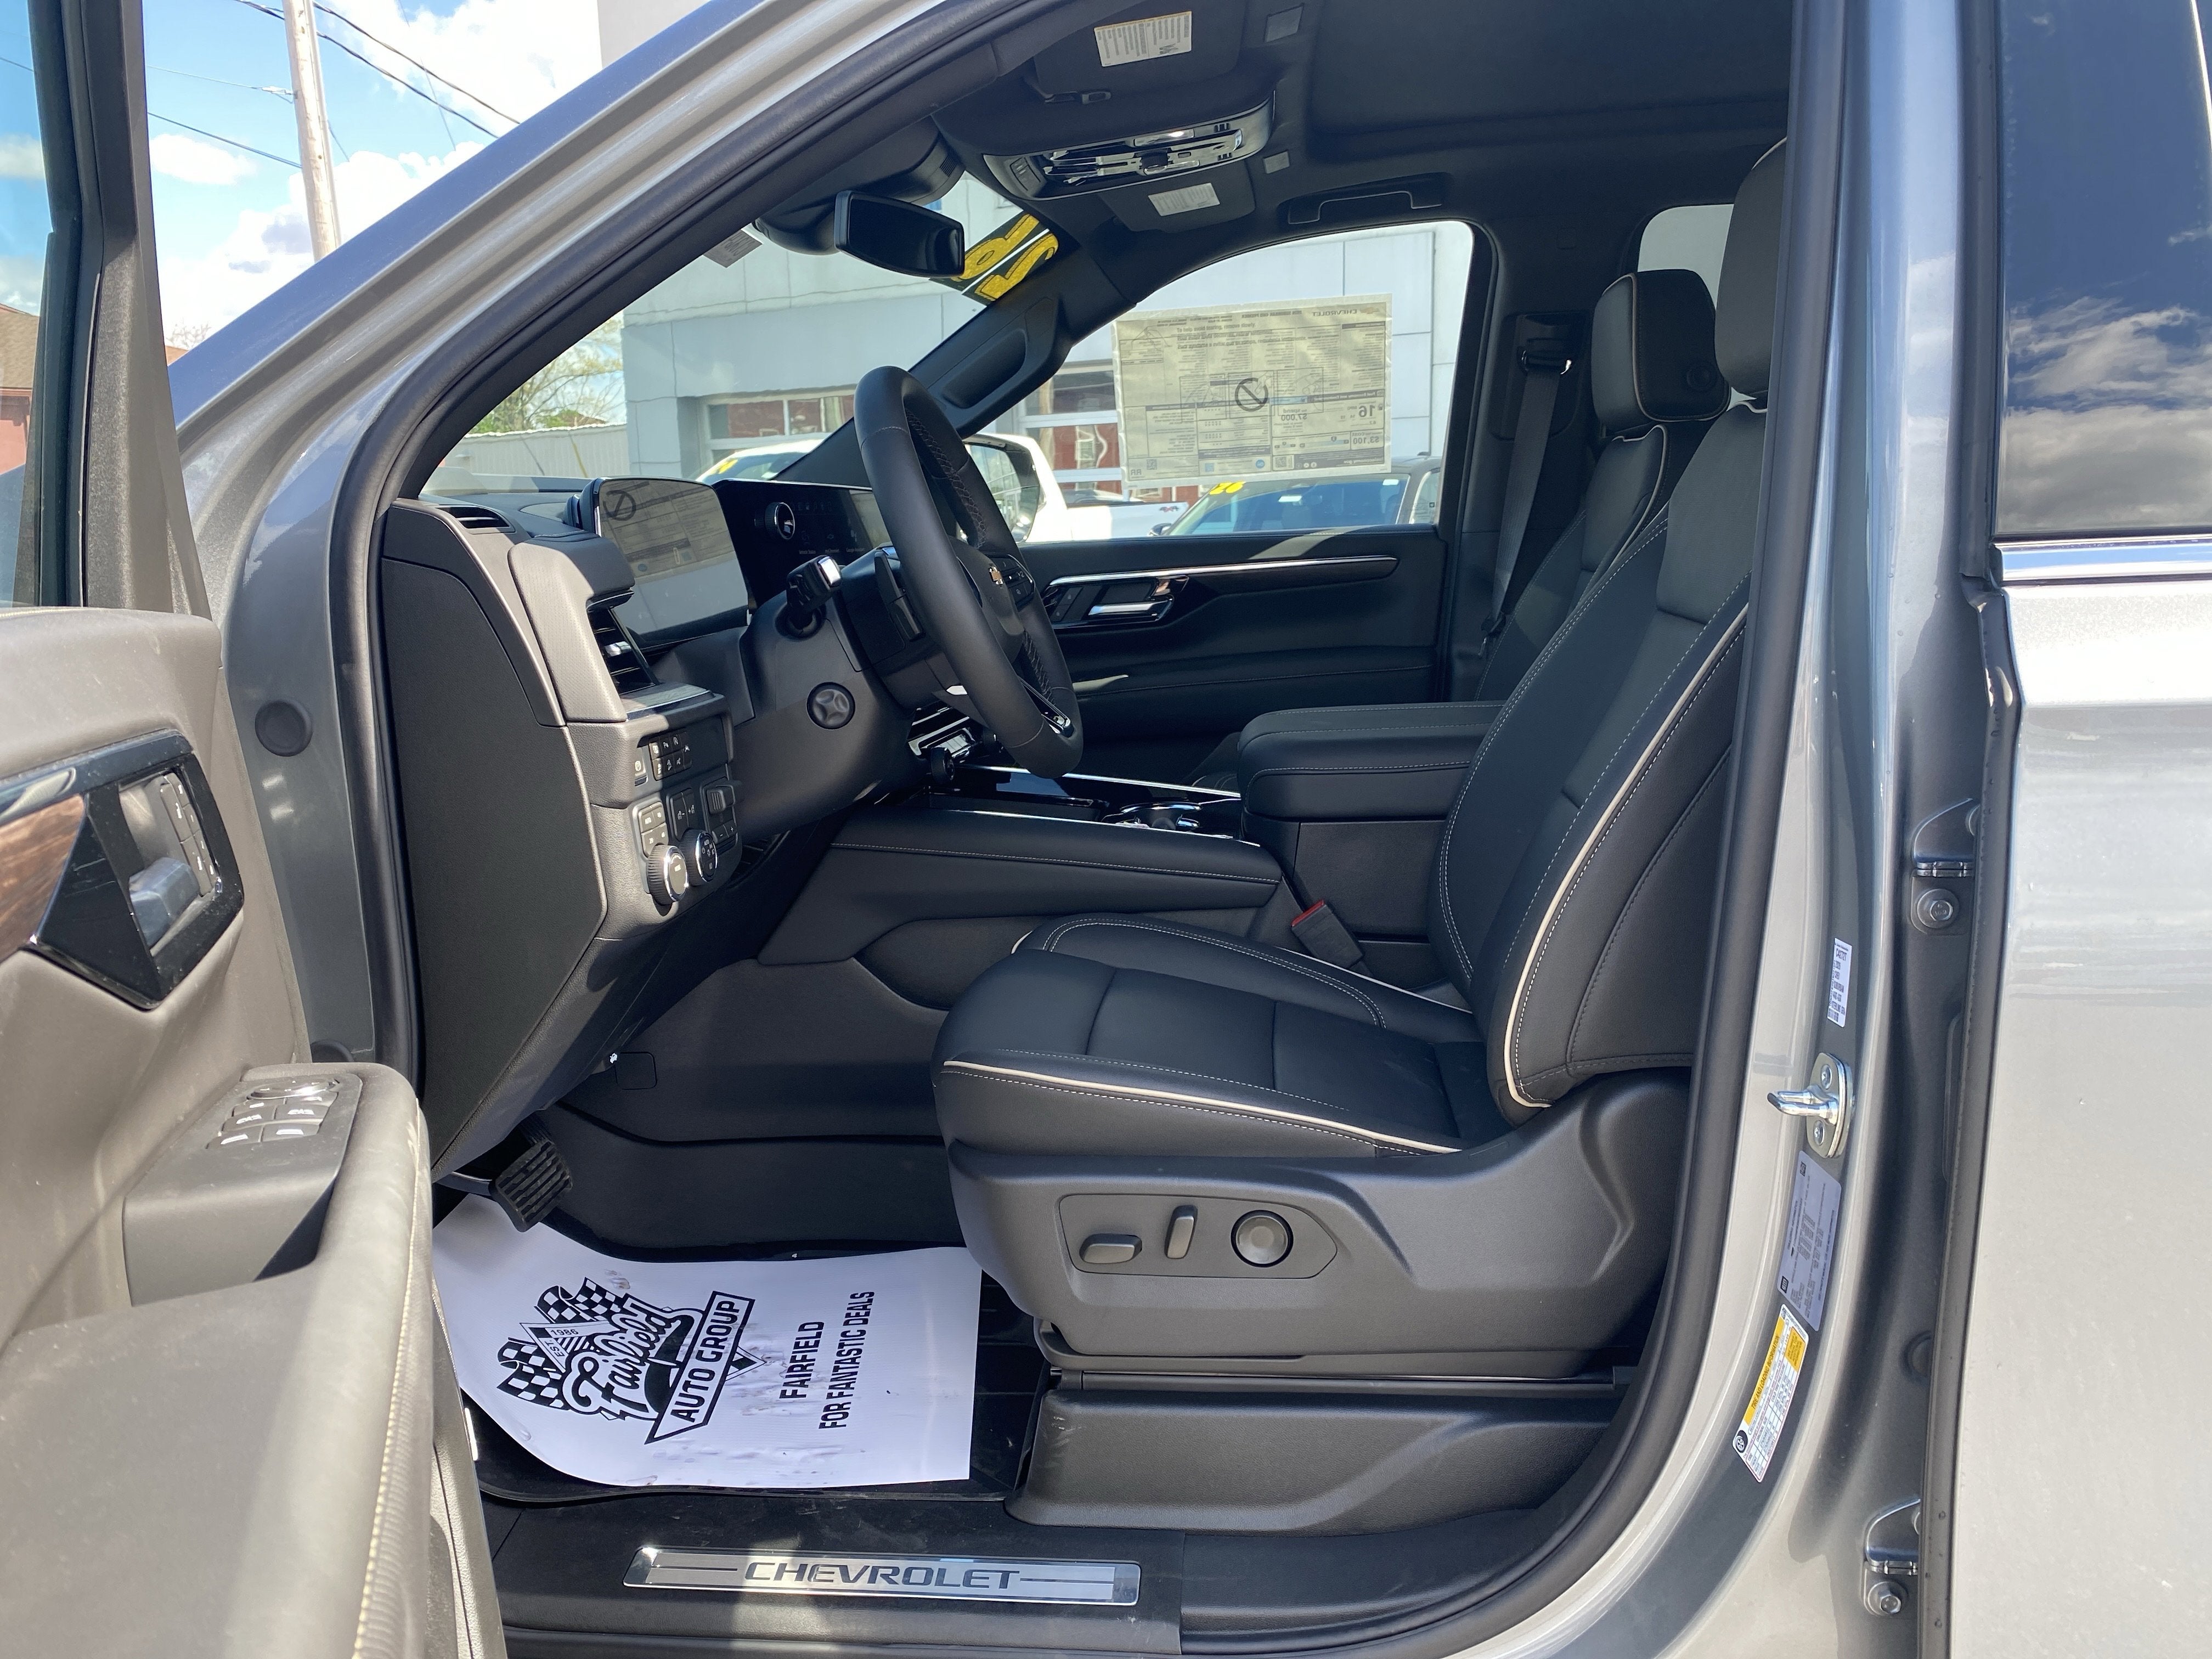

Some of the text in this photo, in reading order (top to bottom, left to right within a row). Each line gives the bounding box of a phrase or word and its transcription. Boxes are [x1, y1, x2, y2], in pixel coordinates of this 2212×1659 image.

[549, 1328, 579, 1357] EST. 1986
[670, 1300, 741, 1423] AUTO GROUP
[778, 1321, 825, 1399] FAIRFIELD
[818, 1291, 875, 1429] FOR FANTASTIC DEALS
[1759, 1363, 1770, 1389] LOADING
[1767, 1333, 1779, 1367] INFORMATION
[744, 1561, 1022, 1590] CHEVROLET
